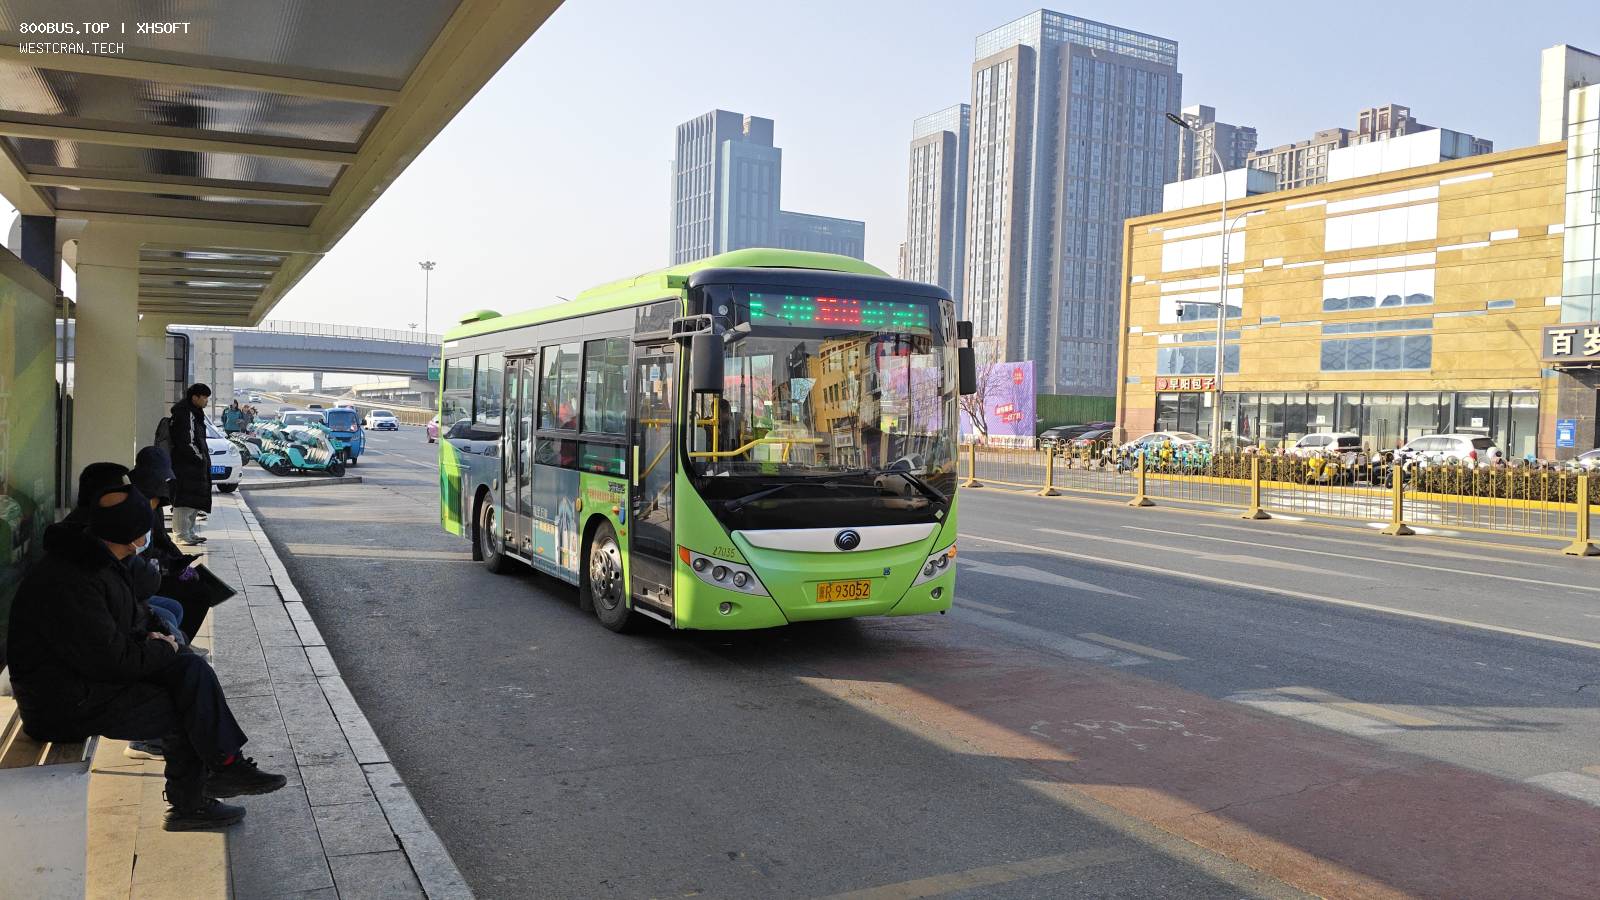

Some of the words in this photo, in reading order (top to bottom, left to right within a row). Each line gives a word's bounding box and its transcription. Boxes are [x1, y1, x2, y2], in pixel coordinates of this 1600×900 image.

[1169, 378, 1214, 390] 早阳包子
[836, 583, 869, 598] 93052
